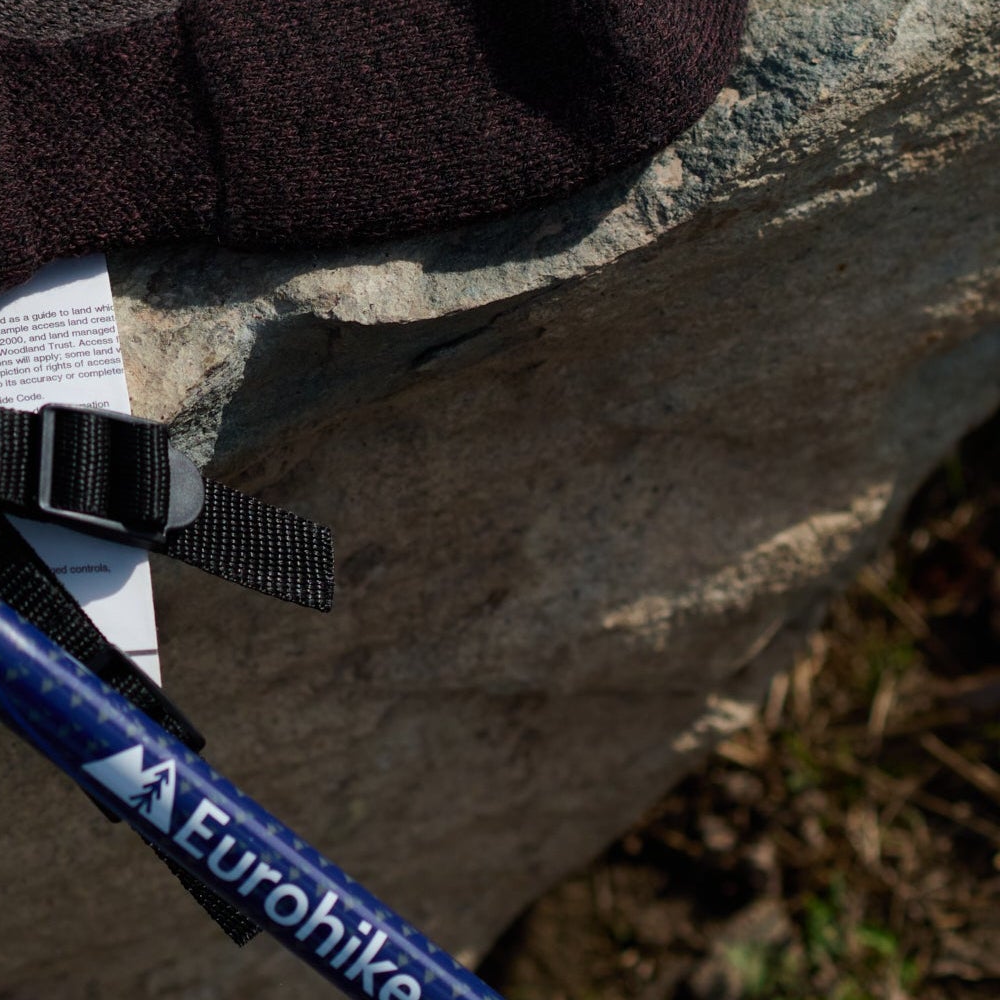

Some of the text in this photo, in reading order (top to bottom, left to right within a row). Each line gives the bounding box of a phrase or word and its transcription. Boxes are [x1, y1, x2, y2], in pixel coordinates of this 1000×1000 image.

[32, 308, 57, 321] guide
[60, 309, 69, 317] to
[72, 305, 92, 314] land
[32, 321, 66, 330] access
[68, 317, 88, 326] land
[29, 333, 47, 342] and
[49, 330, 69, 339] land
[72, 325, 116, 338] managed
[49, 341, 75, 350] Trust.
[78, 337, 114, 346] Access
[65, 350, 91, 359] some
[93, 347, 113, 355] land
[46, 361, 72, 373] rights
[74, 360, 84, 368] of
[87, 357, 121, 367] access
[20, 374, 63, 386] accuracy
[66, 372, 75, 380] or
[16, 393, 45, 402] Code.
[173, 797, 422, 1000] Eurohike
